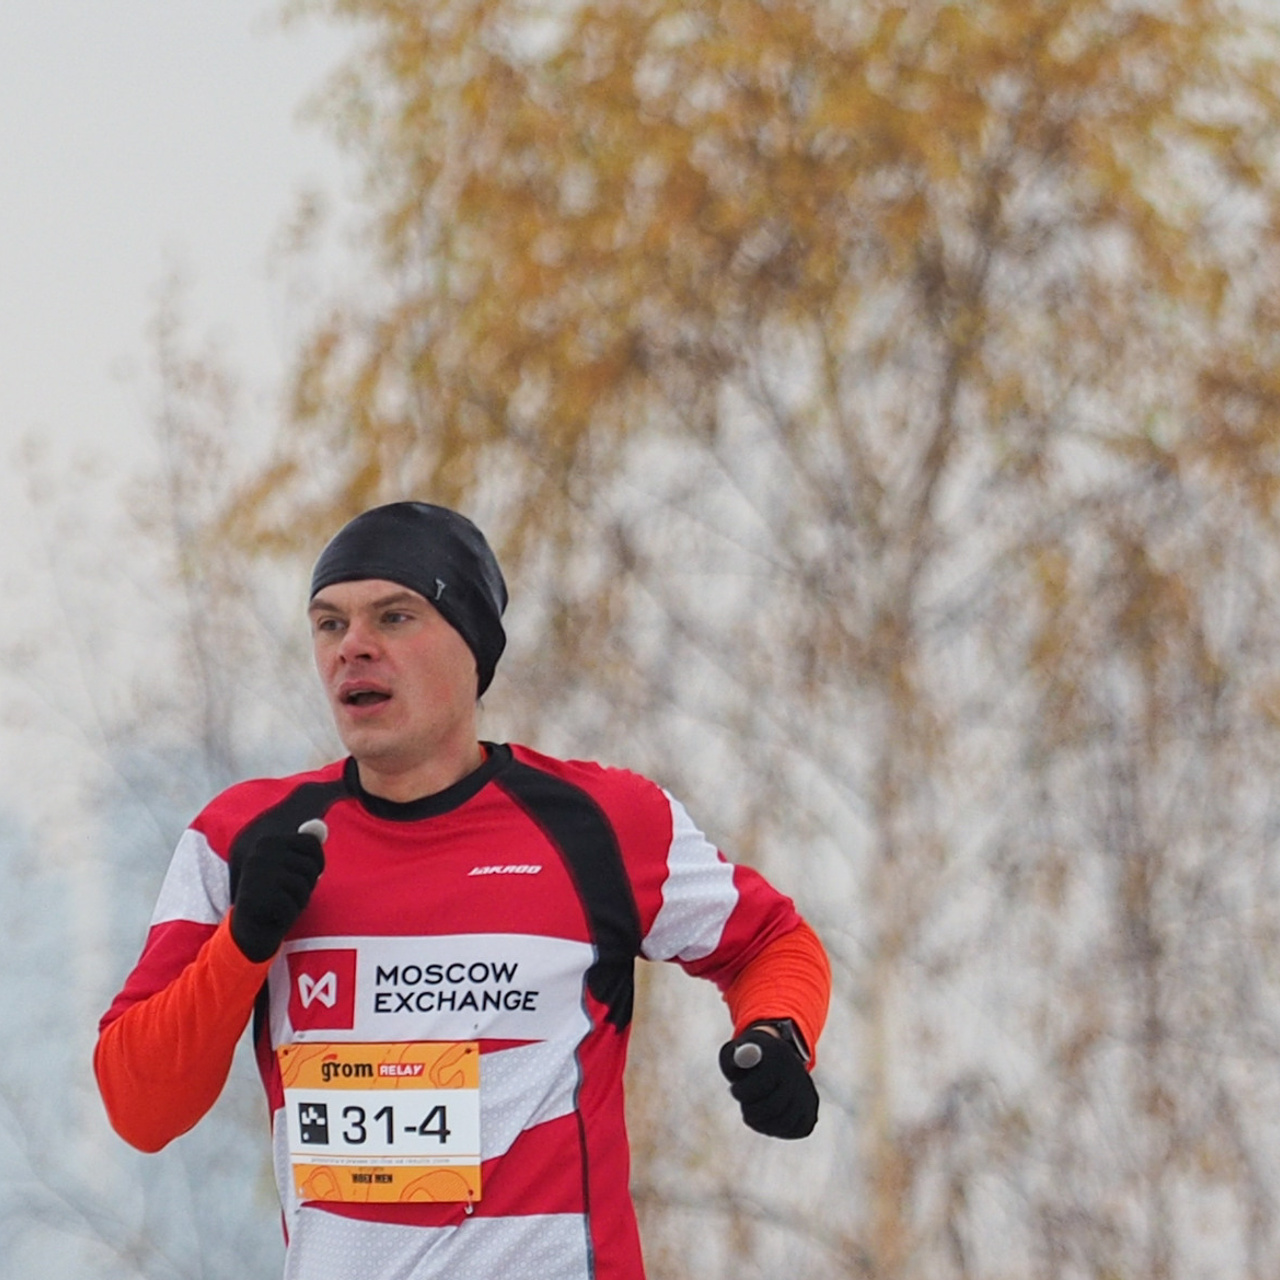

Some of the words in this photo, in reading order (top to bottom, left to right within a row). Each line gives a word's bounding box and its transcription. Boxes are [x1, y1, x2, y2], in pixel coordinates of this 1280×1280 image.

[467, 864, 543, 876] JAKROO
[375, 962, 519, 987] MOSCOW
[374, 990, 540, 1013] EXCHANGE
[321, 1061, 374, 1083] grom
[379, 1063, 424, 1077] RELAY
[342, 1105, 452, 1145] 31-4
